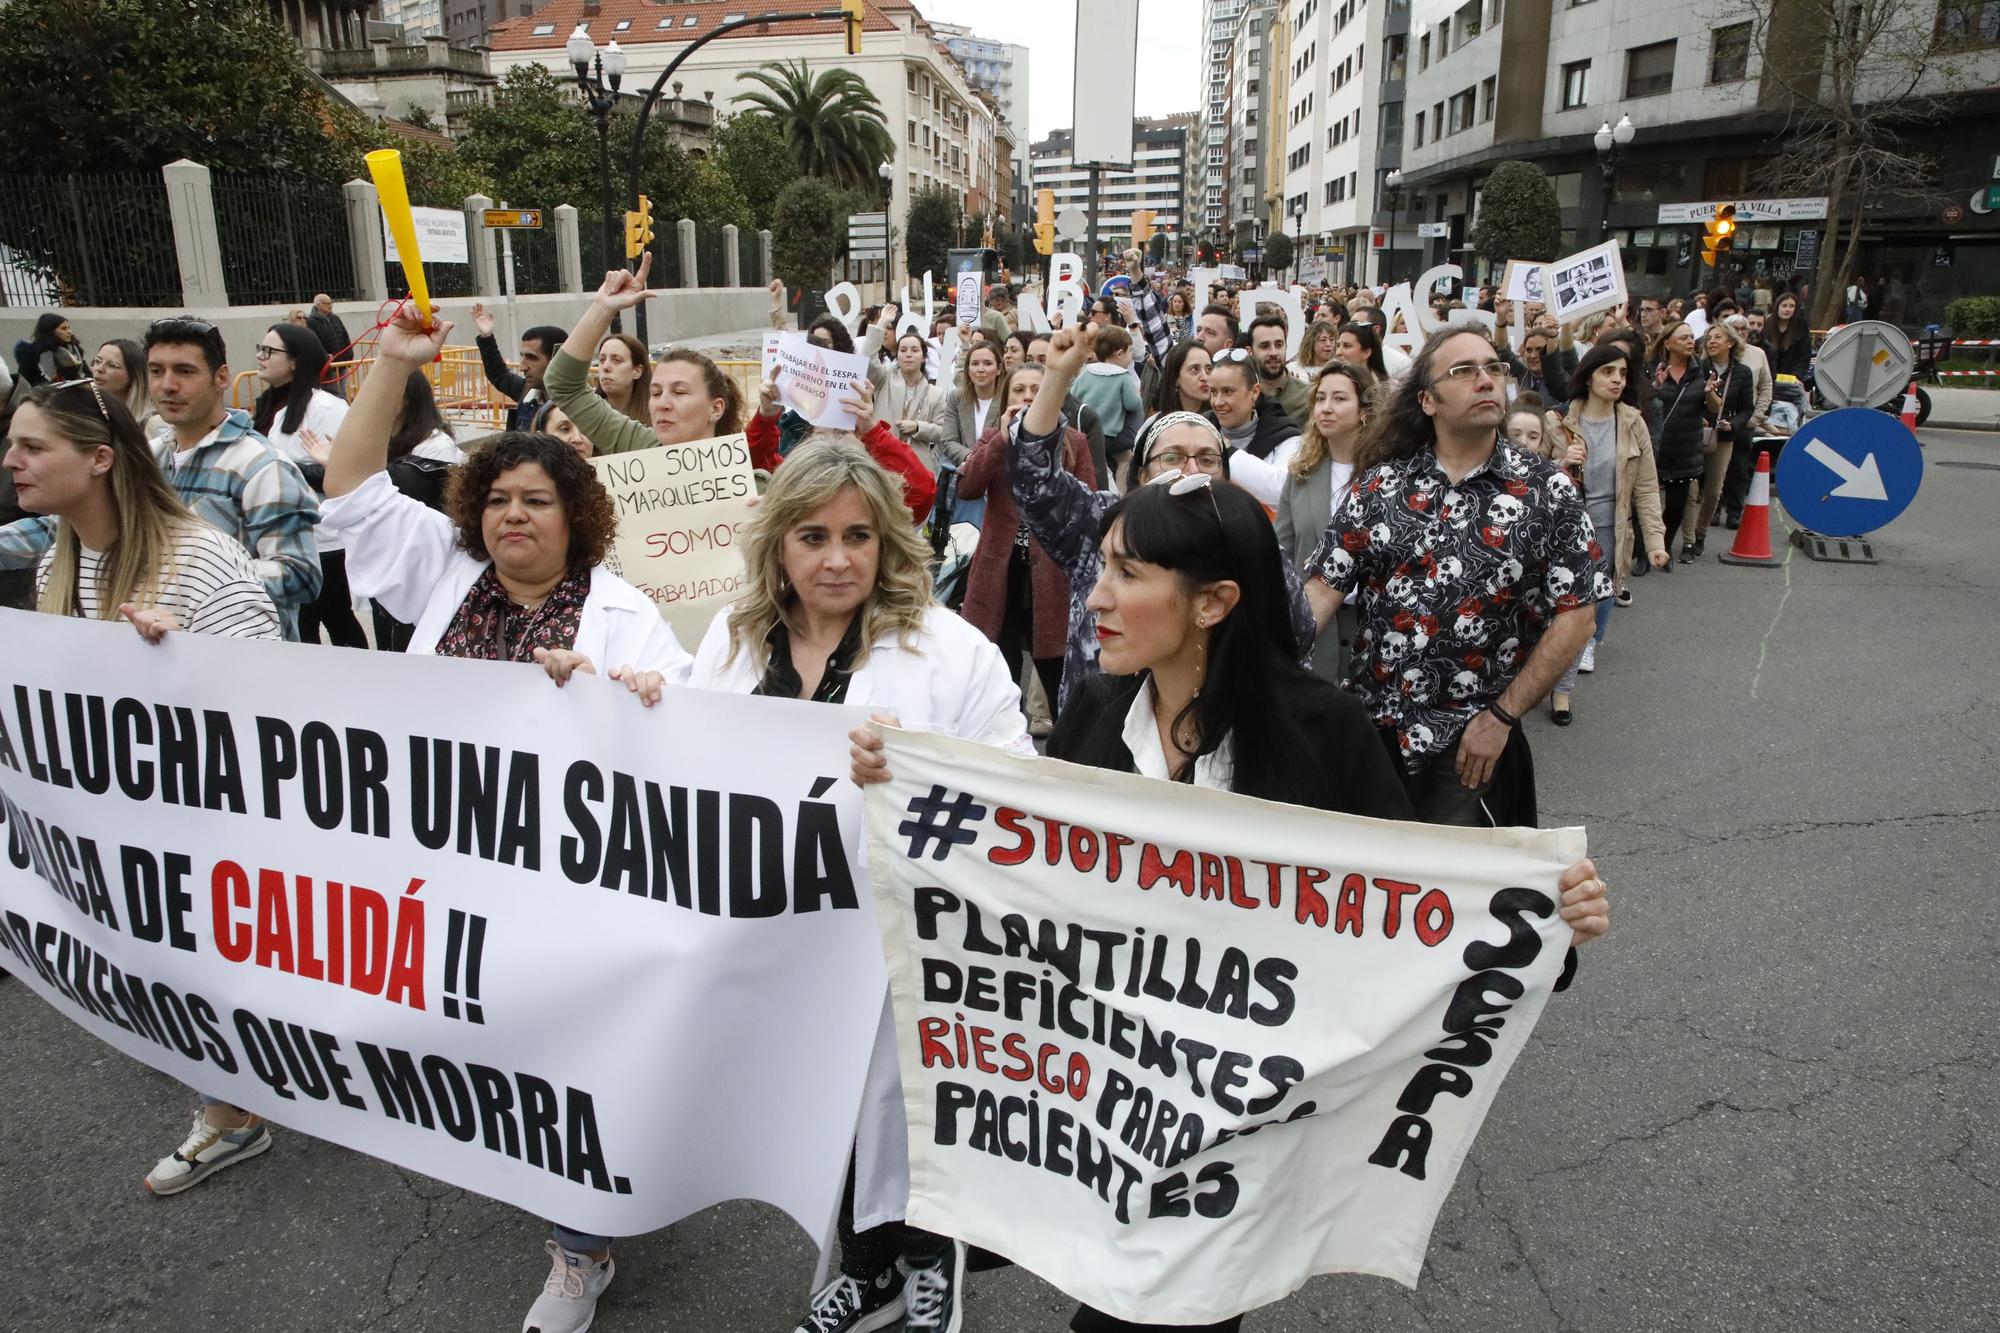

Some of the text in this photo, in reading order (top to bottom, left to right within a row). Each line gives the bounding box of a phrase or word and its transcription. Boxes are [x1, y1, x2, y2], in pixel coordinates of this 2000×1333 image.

[1750, 202, 1782, 216] VILLA
[780, 349, 860, 380] TRABAJAR EN EL SESPA:
[782, 364, 848, 390] EL INFIERNO EN EL
[795, 381, 826, 399] PARAÍSO
[607, 438, 747, 488] NO SOMOS
[617, 474, 748, 516] MARQUESES
[13, 684, 248, 815] LLUCHA
[256, 716, 391, 840] POR
[409, 735, 542, 873] UNA
[560, 760, 860, 919] SANIDÁ
[120, 845, 197, 953] DE
[211, 858, 427, 1012] CALIDÁ
[442, 908, 487, 1026] !!
[1367, 886, 1556, 1181] SESPA
[234, 1009, 368, 1113] QUE
[356, 1041, 634, 1196] MORRA.
[1096, 1067, 1205, 1168] PARA
